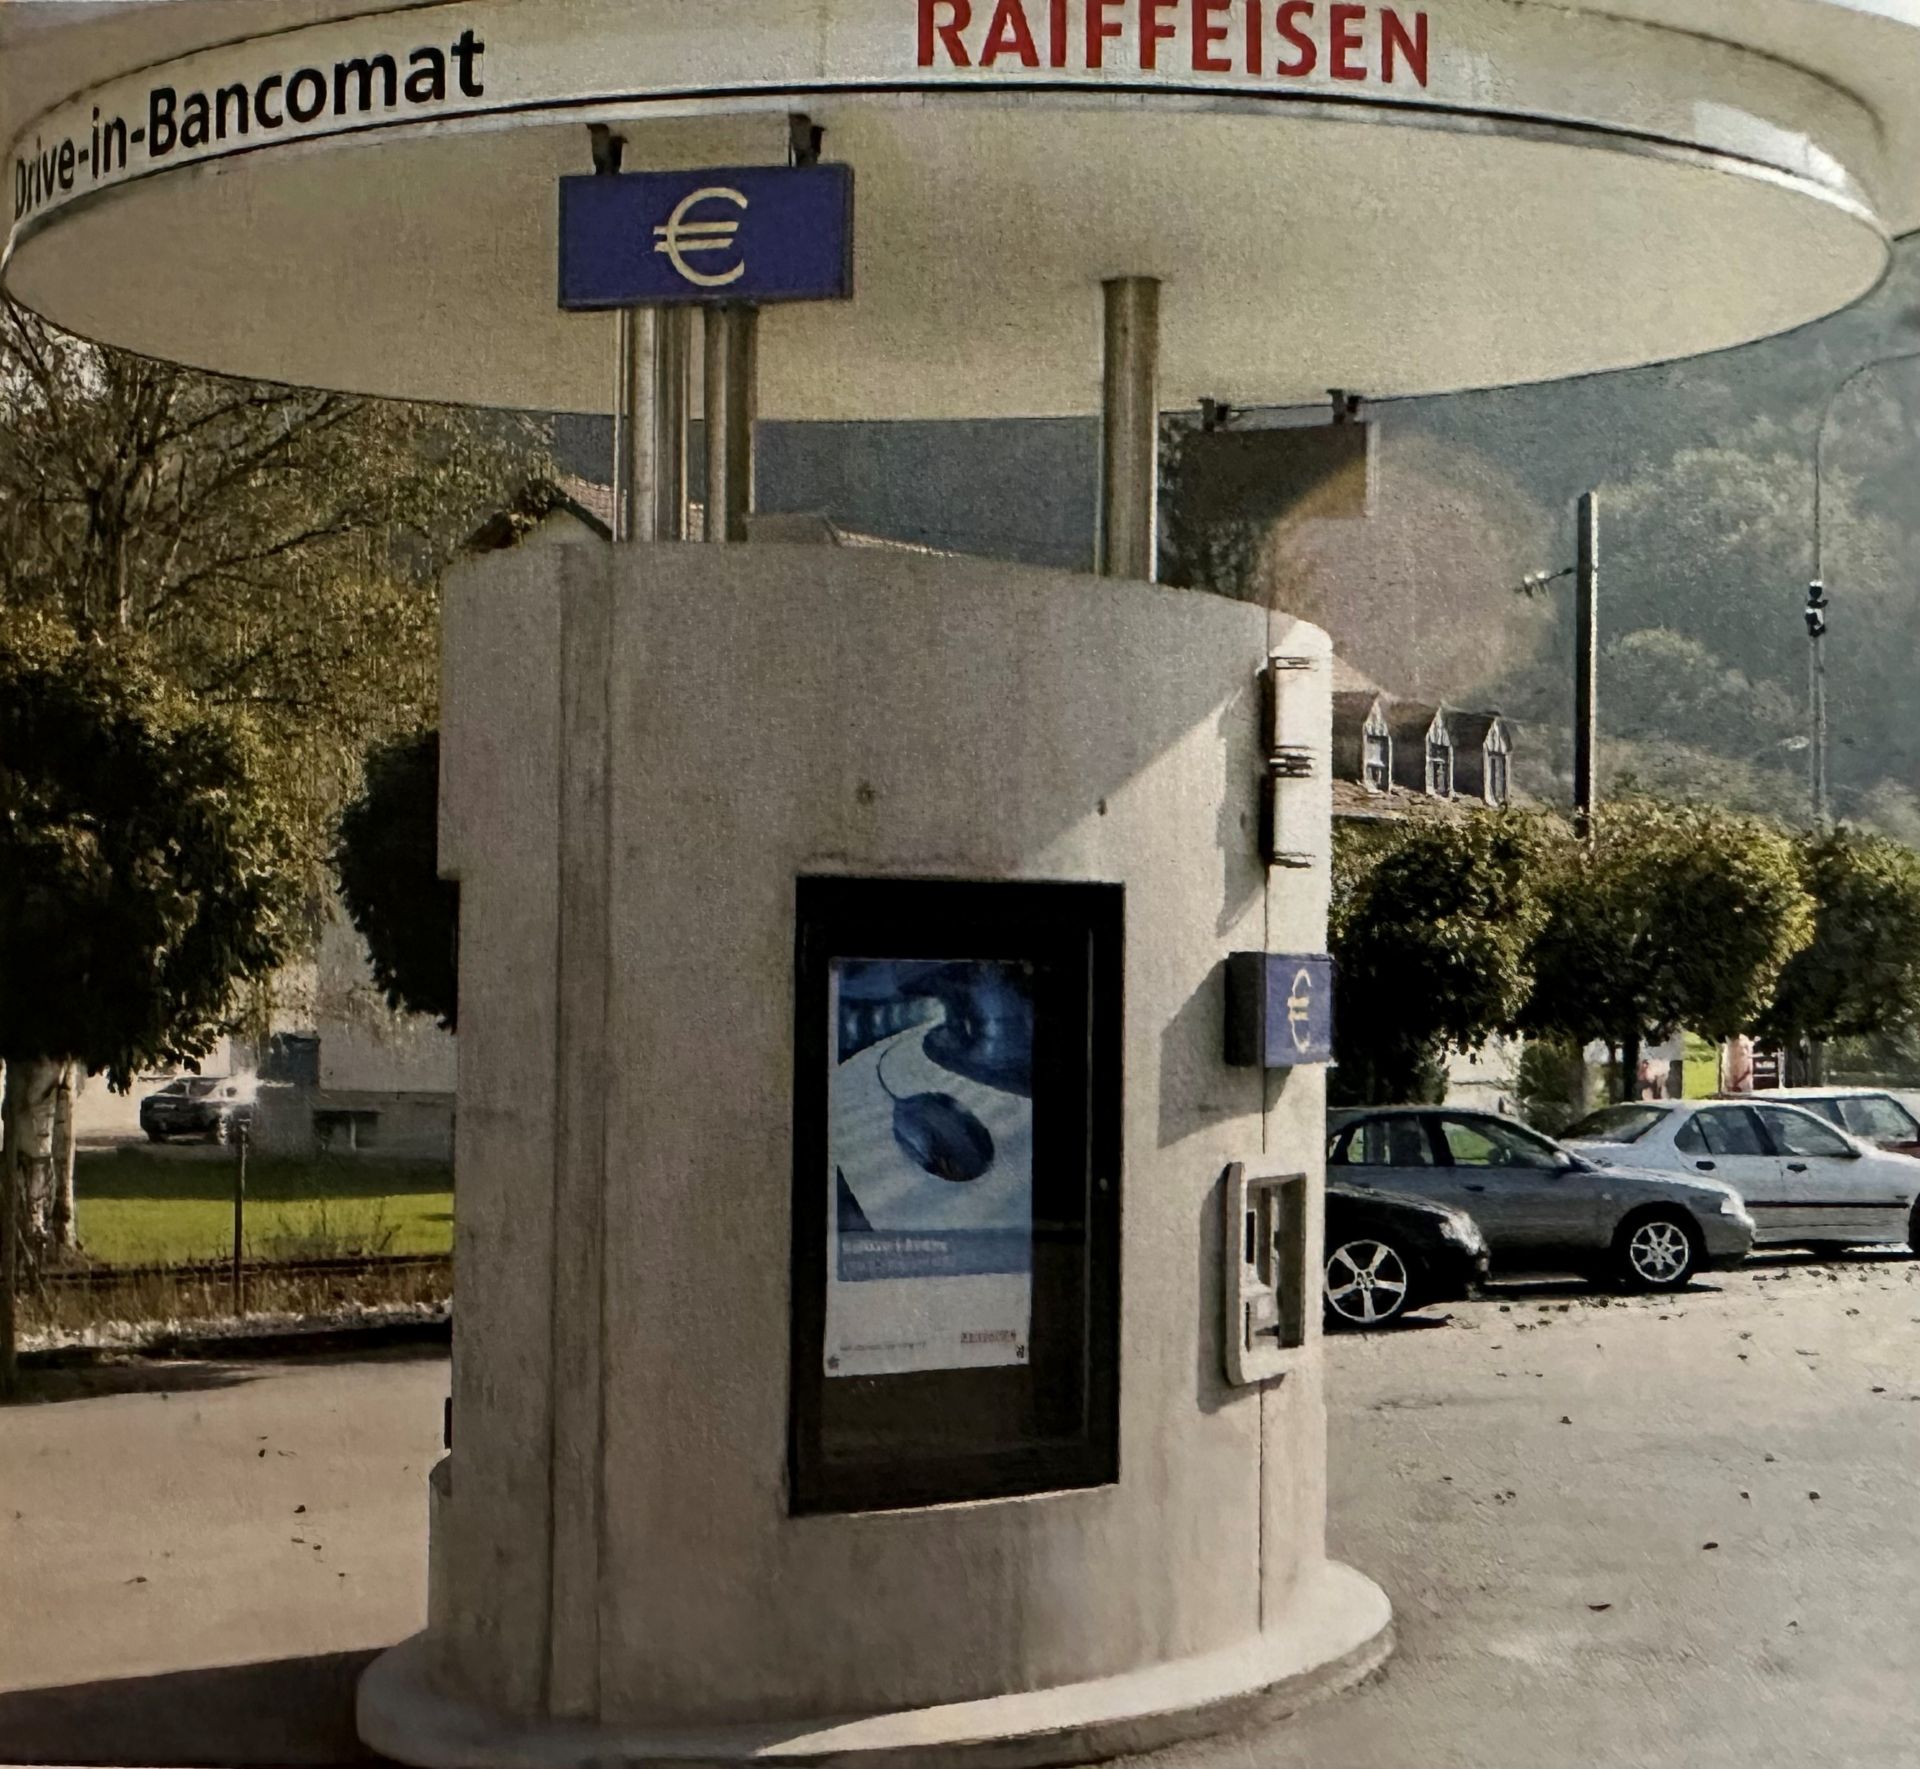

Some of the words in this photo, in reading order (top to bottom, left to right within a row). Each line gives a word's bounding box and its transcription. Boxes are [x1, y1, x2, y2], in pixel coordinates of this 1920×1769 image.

[917, 0, 1428, 87] RAIFFEISEN
[14, 28, 486, 221] Drive-in-Bancomat
[653, 187, 748, 286] €
